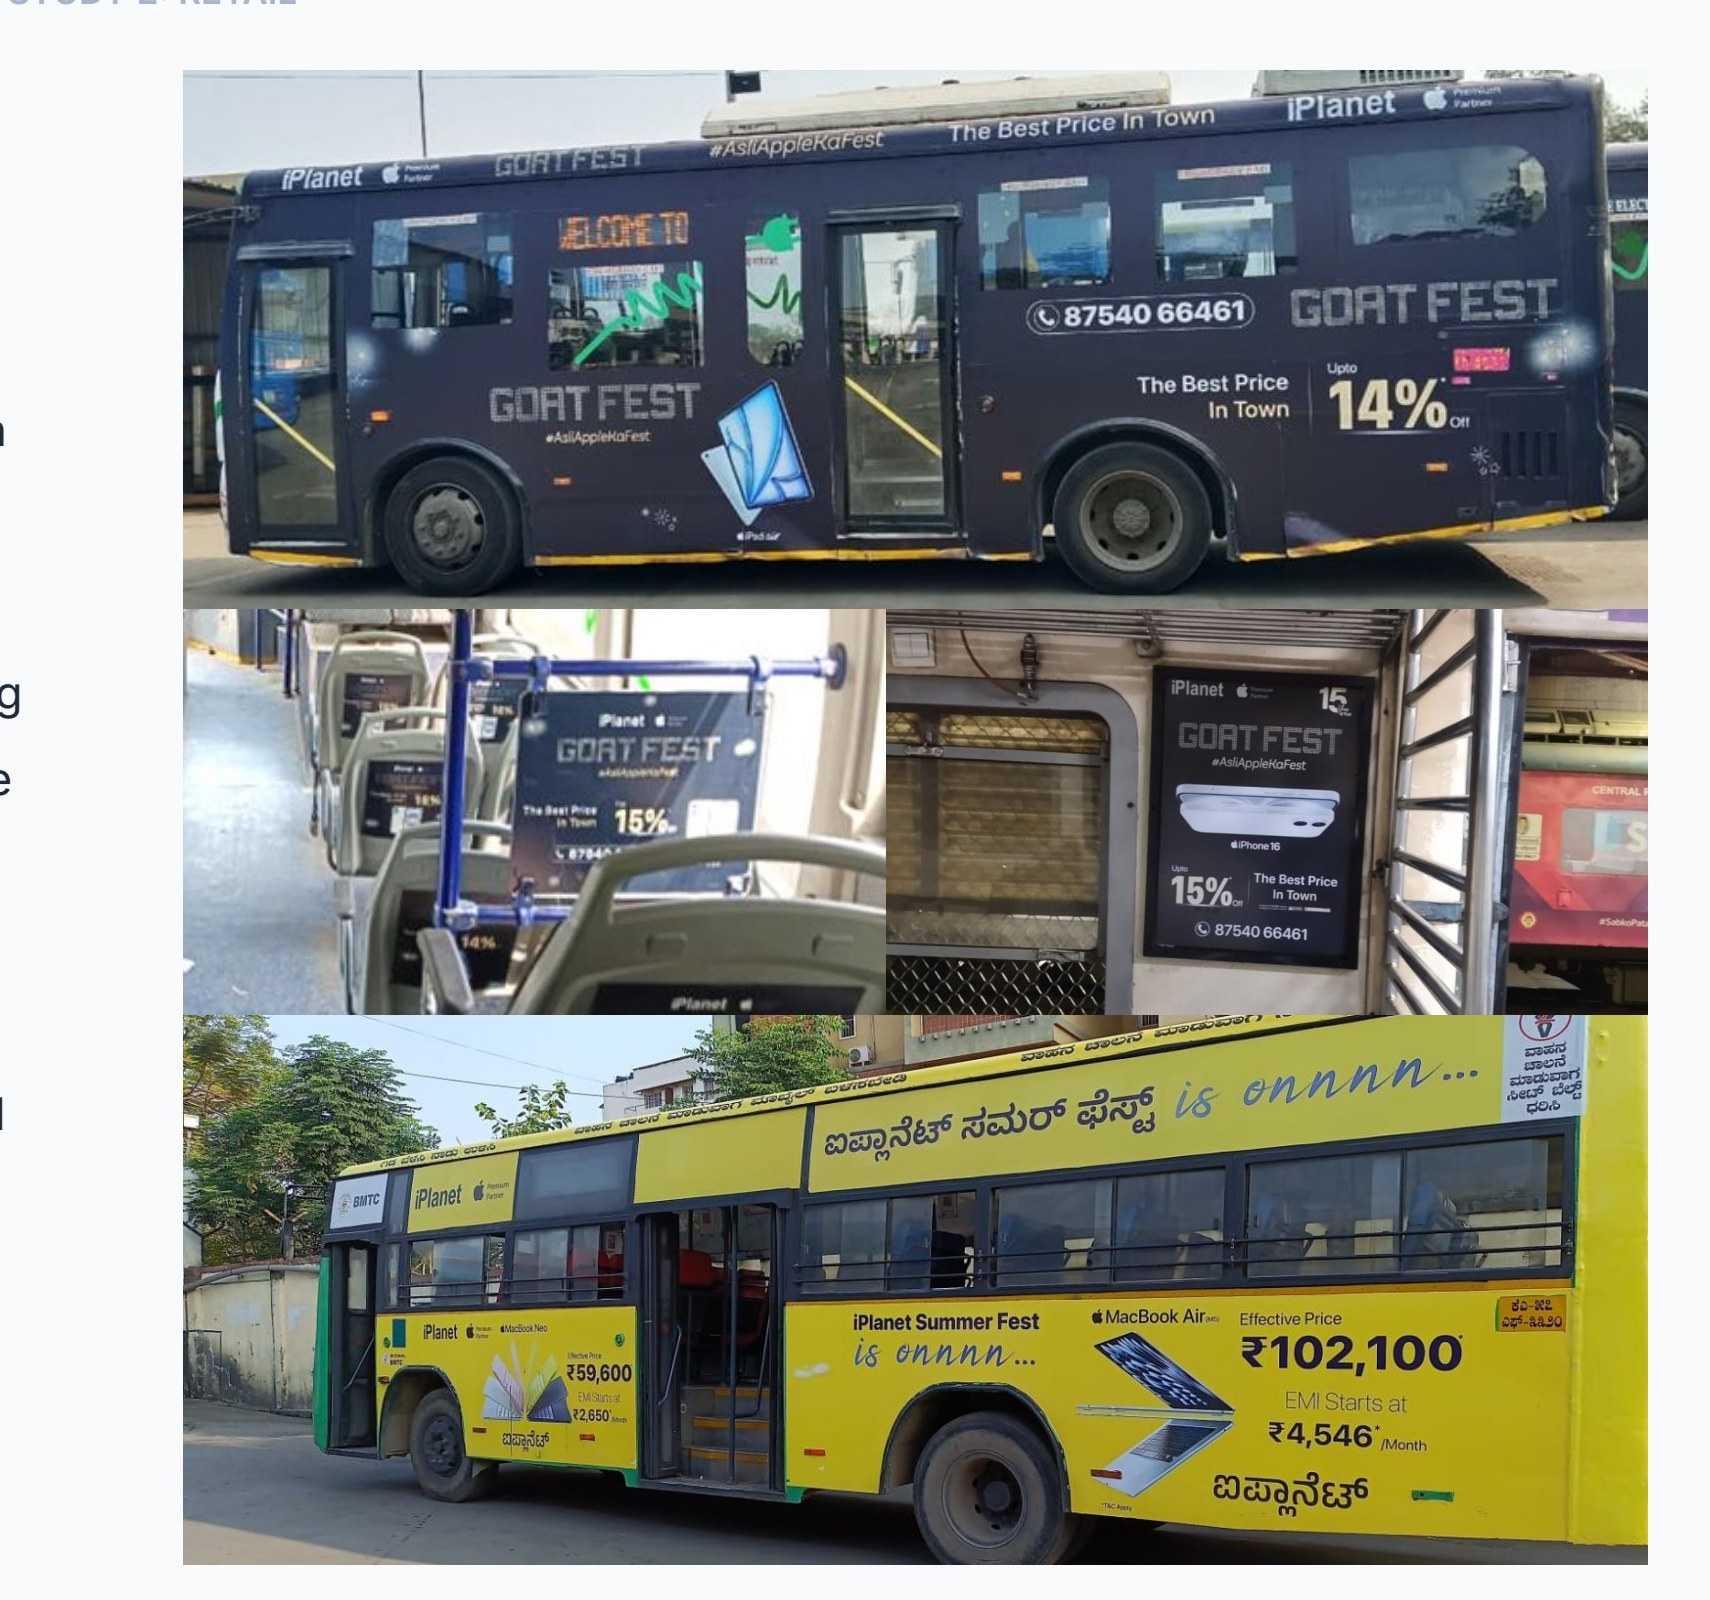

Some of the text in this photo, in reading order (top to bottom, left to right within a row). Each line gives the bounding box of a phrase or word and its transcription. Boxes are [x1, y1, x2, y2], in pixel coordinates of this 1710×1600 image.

[1287, 88, 1396, 122] iPlanet
[948, 108, 1216, 143] The Best Price In Town
[709, 130, 886, 159] #AsliAppleKaFest
[493, 145, 647, 178] GOAT FEST
[281, 166, 363, 191] iPlanet
[1290, 279, 1558, 328] GOAT FEST
[1064, 301, 1246, 328] 87540 66461
[1327, 362, 1358, 376] Upto
[1137, 374, 1289, 394] The Best Price
[489, 382, 701, 422] GOAT FEST
[1209, 400, 1290, 419] In Town
[1450, 416, 1471, 429] Off
[1171, 680, 1224, 697] iPlanet
[1178, 721, 1343, 755] GOAT FEST
[557, 736, 722, 763] GOAT FEST
[1211, 756, 1308, 772] #AsliAppleKaFest
[1591, 784, 1641, 797] CENTRAL
[1238, 840, 1281, 851] iPhone 16
[1254, 872, 1338, 888] The Best Price
[1170, 875, 1234, 908] 15%
[1272, 889, 1317, 902] In Town
[1215, 924, 1308, 941] 87540 66461
[1525, 1041, 1567, 1057] ವಾಹನ
[824, 1112, 953, 1162] ಐಪ್ಲಾನೆಟ್
[961, 1098, 1067, 1140] ಸಮರ್
[1175, 1080, 1221, 1119] is
[353, 1191, 380, 1208] BMTC
[414, 1183, 462, 1210] iPlanet
[853, 1312, 1040, 1331] iPlanet Summer Fest
[1105, 1309, 1178, 1324] MacBook
[1183, 1308, 1206, 1323] Air
[1239, 1312, 1342, 1326] Effective Price
[423, 1324, 458, 1340] iPlanet
[854, 1337, 884, 1367] is
[1285, 1391, 1407, 1413] EMI Starts at
[1380, 1437, 1427, 1453] /Month
[1213, 1471, 1369, 1518] ಐಪ್ಲಾನೆಟ್
